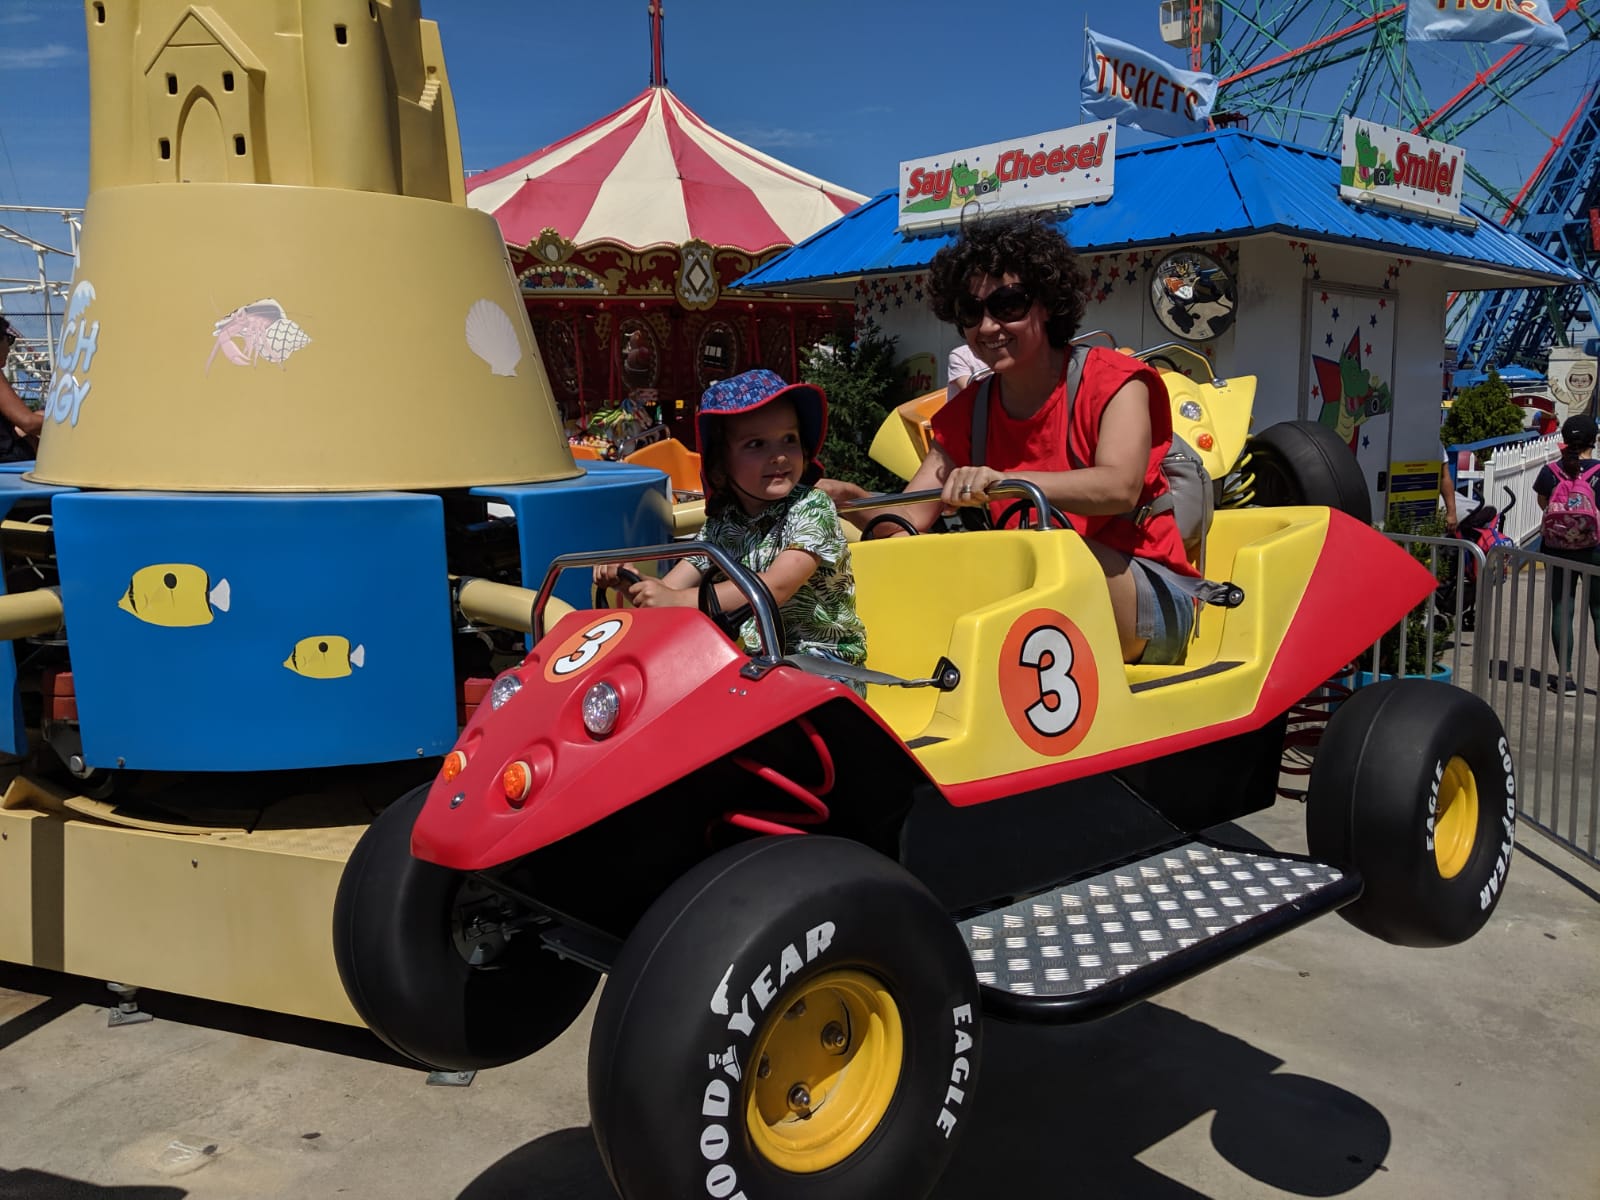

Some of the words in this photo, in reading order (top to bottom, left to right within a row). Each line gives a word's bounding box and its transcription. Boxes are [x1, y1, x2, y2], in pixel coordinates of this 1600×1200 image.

[1096, 53, 1199, 121] TICKETS
[906, 167, 952, 201] Say
[995, 132, 1109, 182] Cheese!
[1393, 142, 1457, 197] Smile!
[57, 319, 99, 373] CH
[553, 619, 623, 675] 3
[1019, 625, 1081, 737] 3
[1426, 760, 1445, 850] EAGLE
[936, 1003, 973, 1139] EAGLE
